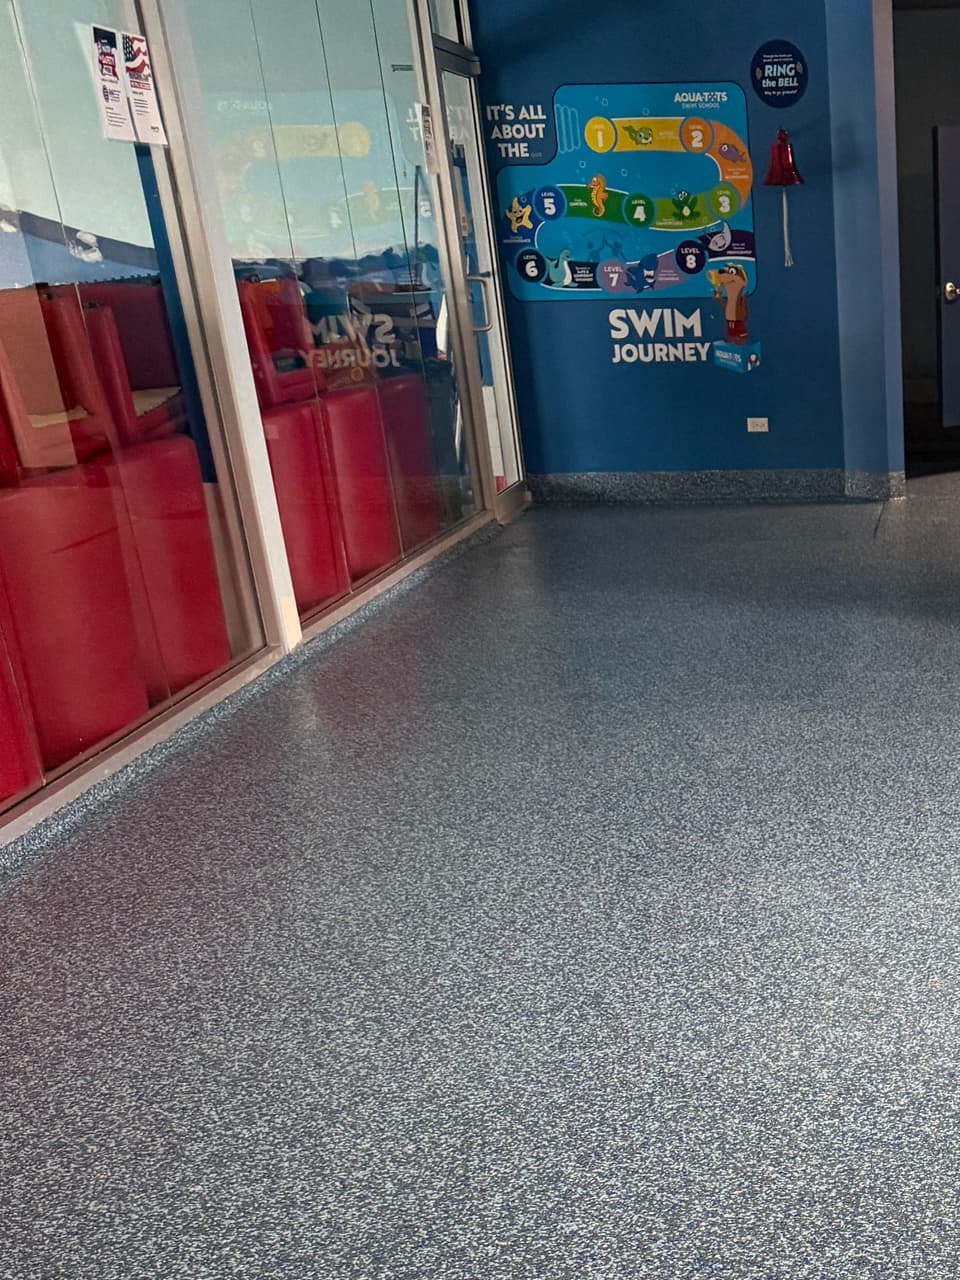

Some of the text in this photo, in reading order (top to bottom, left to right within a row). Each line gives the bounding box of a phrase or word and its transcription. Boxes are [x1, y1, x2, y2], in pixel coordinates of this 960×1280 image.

[764, 63, 796, 77] RING
[762, 77, 799, 88] the BELL
[486, 104, 547, 121] IT'S ALL
[491, 123, 546, 139] ABOUT
[597, 130, 604, 148] 1
[691, 130, 703, 148] 2
[497, 142, 530, 158] THE
[543, 198, 556, 216] 5
[718, 195, 731, 214] 3
[633, 205, 646, 222] 4
[525, 260, 539, 277] 6
[685, 254, 697, 269] 8
[609, 273, 619, 288] 7
[608, 308, 702, 339] SWIM
[612, 342, 711, 363] JOURNEY
